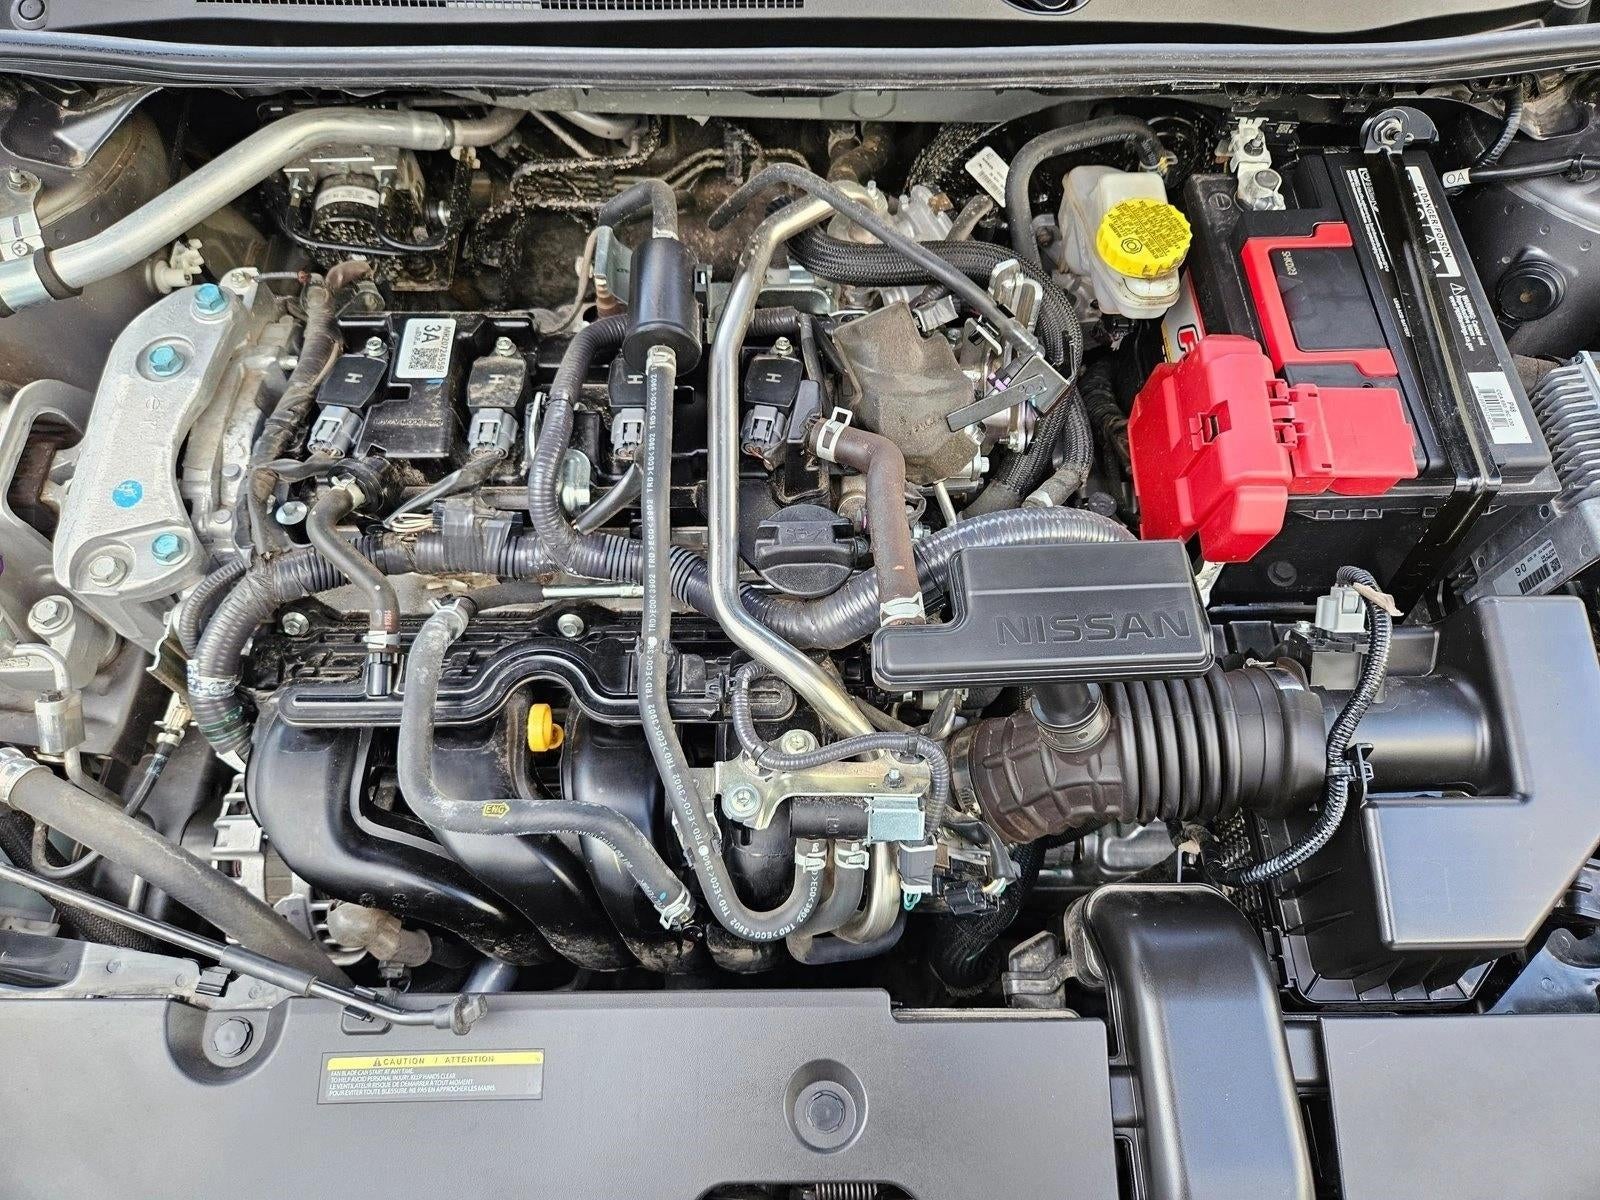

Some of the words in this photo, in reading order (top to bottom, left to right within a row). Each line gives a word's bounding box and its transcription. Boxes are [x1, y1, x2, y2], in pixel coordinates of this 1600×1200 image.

[1447, 172, 1465, 184] OA
[422, 325, 442, 343] 3A
[344, 372, 362, 383] H
[488, 374, 504, 383] H
[627, 374, 643, 384] H
[765, 372, 781, 382] H
[1514, 563, 1527, 576] 90
[995, 610, 1192, 646] NISSAN
[485, 805, 506, 814] ENG
[383, 1057, 425, 1066] CAUTION
[445, 1055, 495, 1064] ATTENTION
